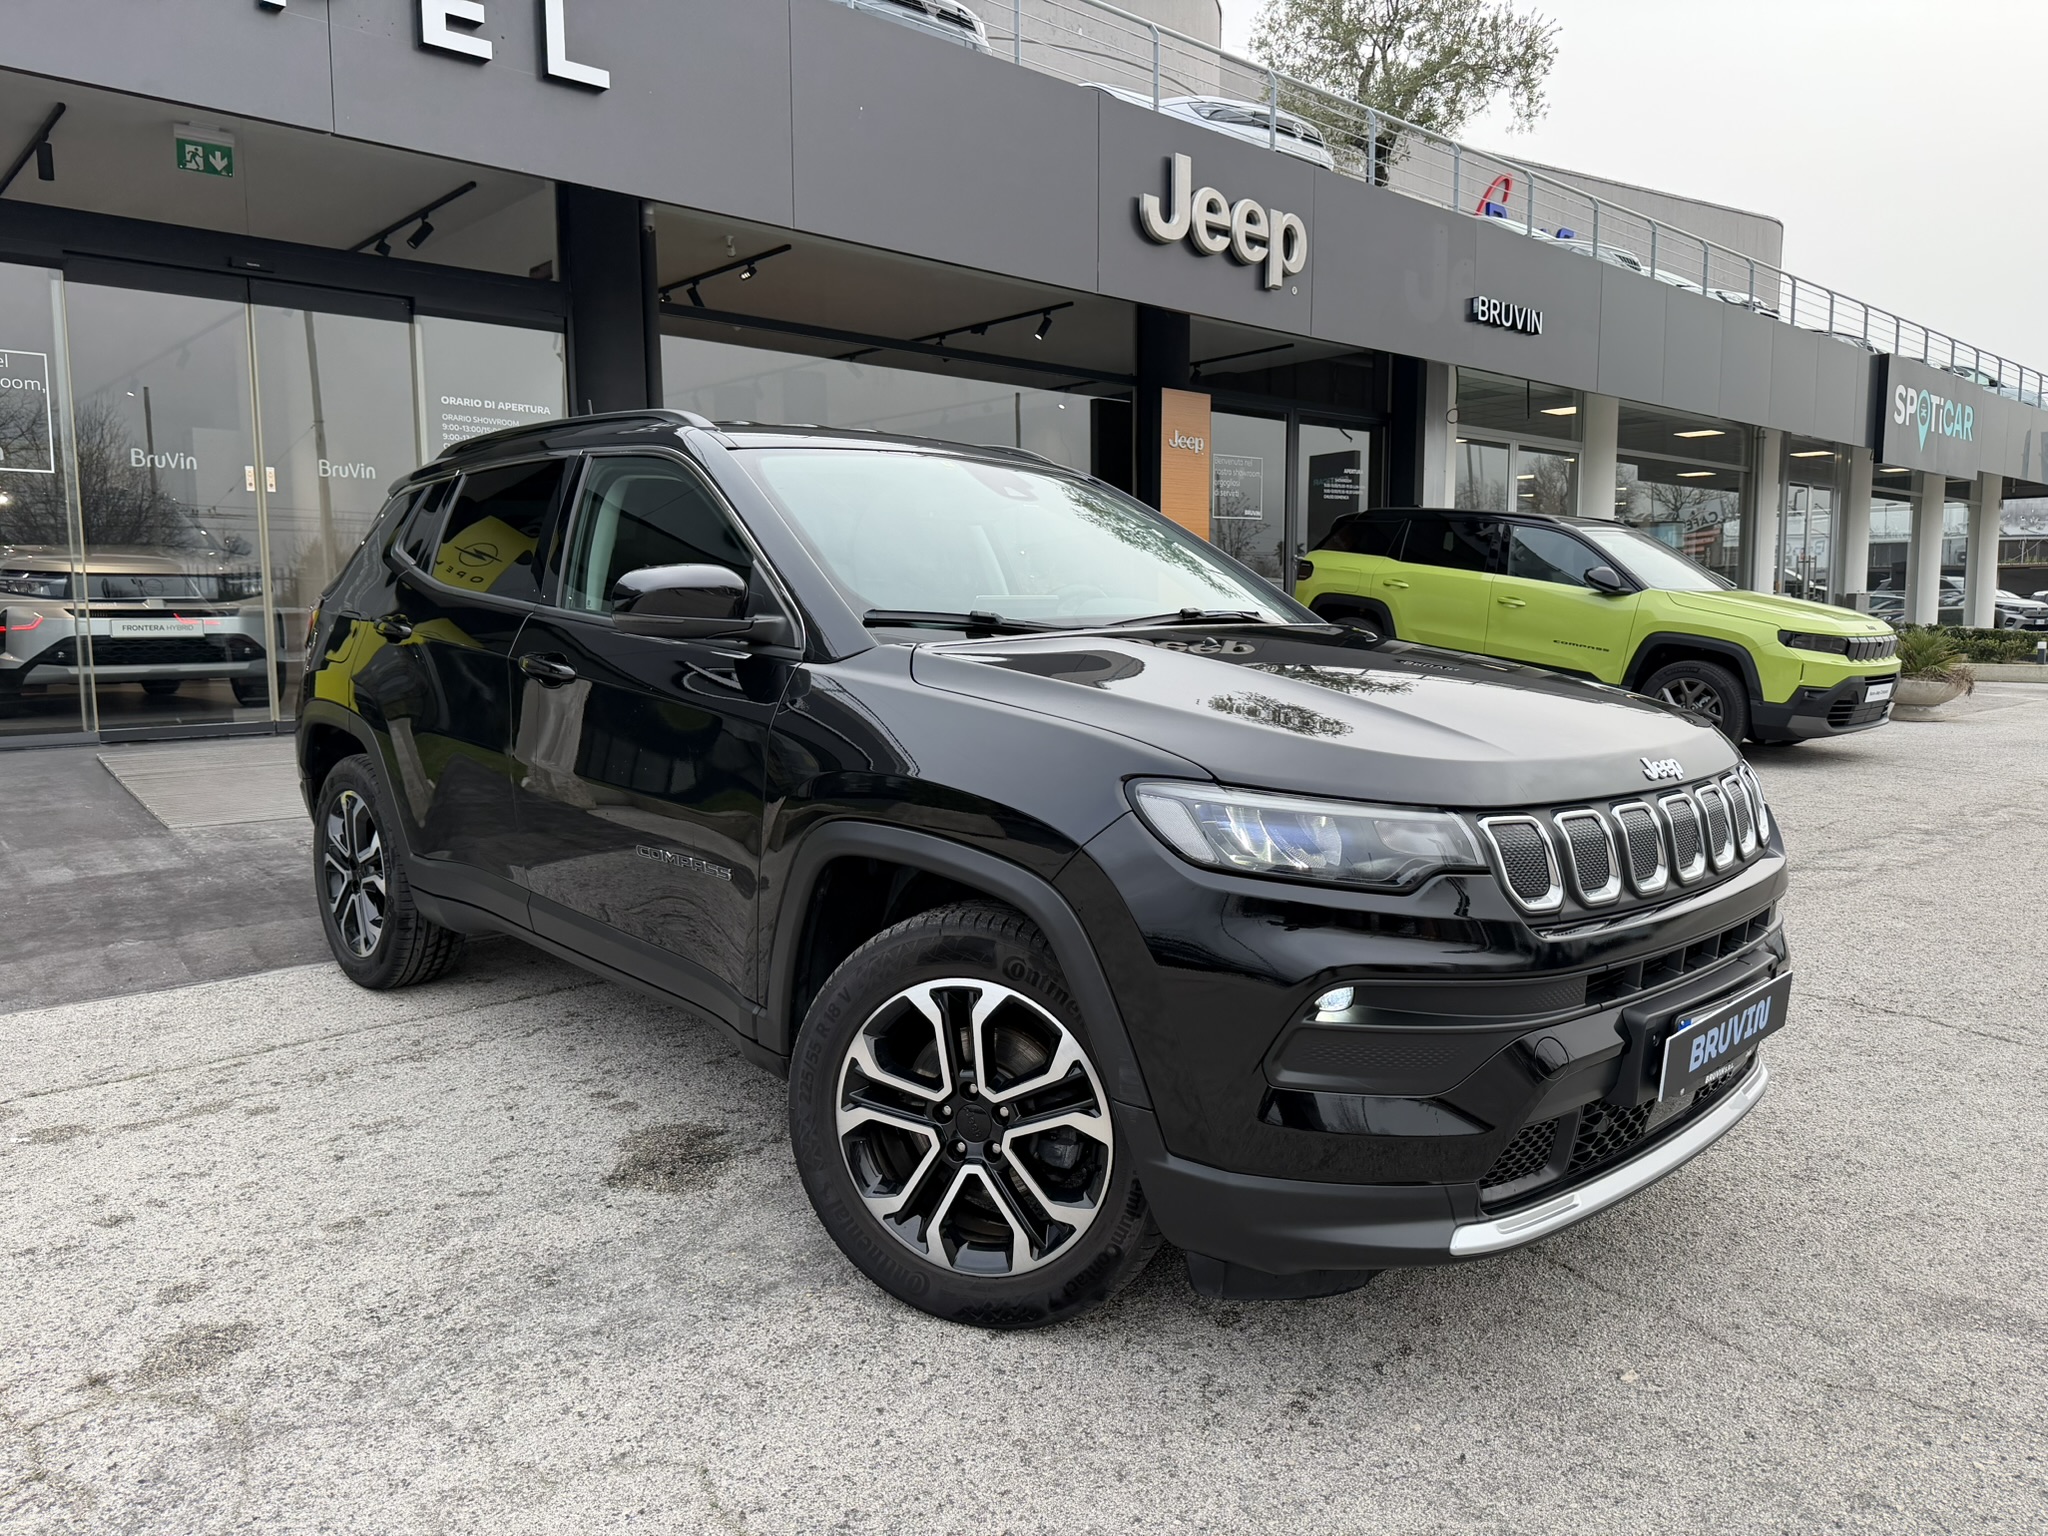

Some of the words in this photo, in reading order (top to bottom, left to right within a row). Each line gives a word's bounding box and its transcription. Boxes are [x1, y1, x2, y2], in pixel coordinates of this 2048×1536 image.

[1139, 152, 1307, 290] Jeep
[1477, 296, 1543, 335] BRUVIN
[441, 396, 482, 408] ORARIO
[484, 400, 495, 409] DI
[498, 402, 551, 415] APERTURA
[442, 413, 471, 423] ORARIO
[473, 416, 520, 427] SHOWROOM
[1168, 430, 1204, 454] Jeep
[130, 448, 198, 470] BruVin
[317, 459, 376, 479] BruVin
[122, 624, 165, 632] FRONTERA
[166, 624, 194, 632] HYBRID
[1640, 757, 1684, 781] Jeep
[636, 845, 732, 881] COMPASS
[1689, 996, 1771, 1073] BRUVIN
[798, 1039, 822, 1105] 225/55
